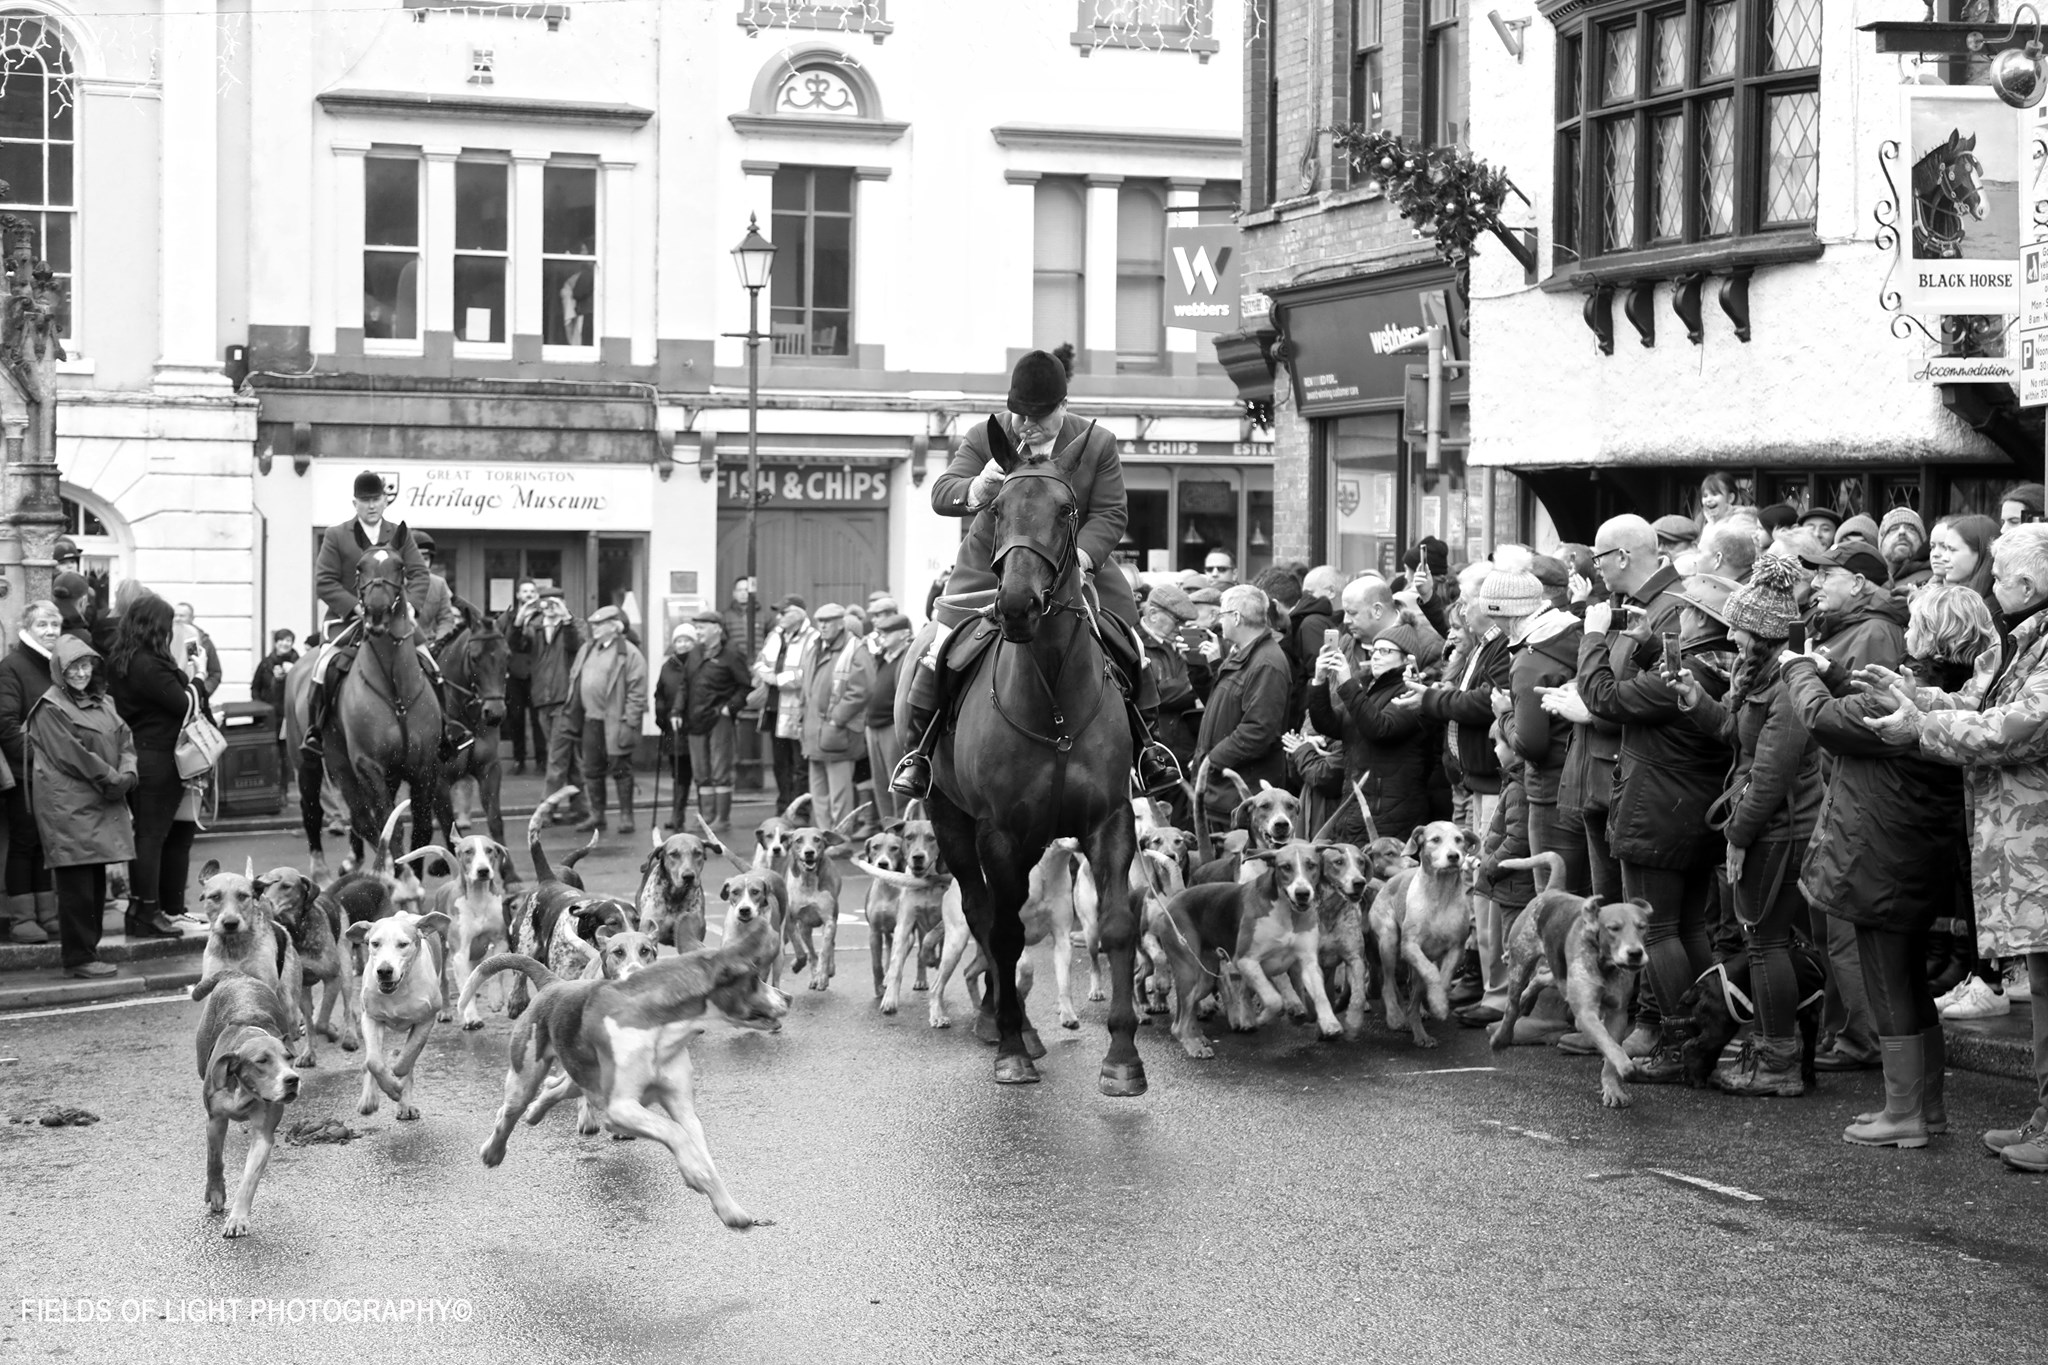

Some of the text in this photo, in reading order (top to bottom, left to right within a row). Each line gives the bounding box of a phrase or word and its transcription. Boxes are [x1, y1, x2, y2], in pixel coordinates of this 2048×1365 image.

[1918, 273, 2013, 288] BLACK HORSE
[1173, 301, 1230, 317] webbers
[1369, 323, 1420, 354] webbers
[1913, 361, 2015, 381] Accommodation
[1123, 441, 1136, 454] &
[1148, 441, 1199, 455] CHIPS
[427, 469, 576, 483] GREAT TORRINGTON
[782, 471, 804, 500] &
[806, 471, 888, 501] CHIPS
[406, 483, 608, 516] Heritage Museum
